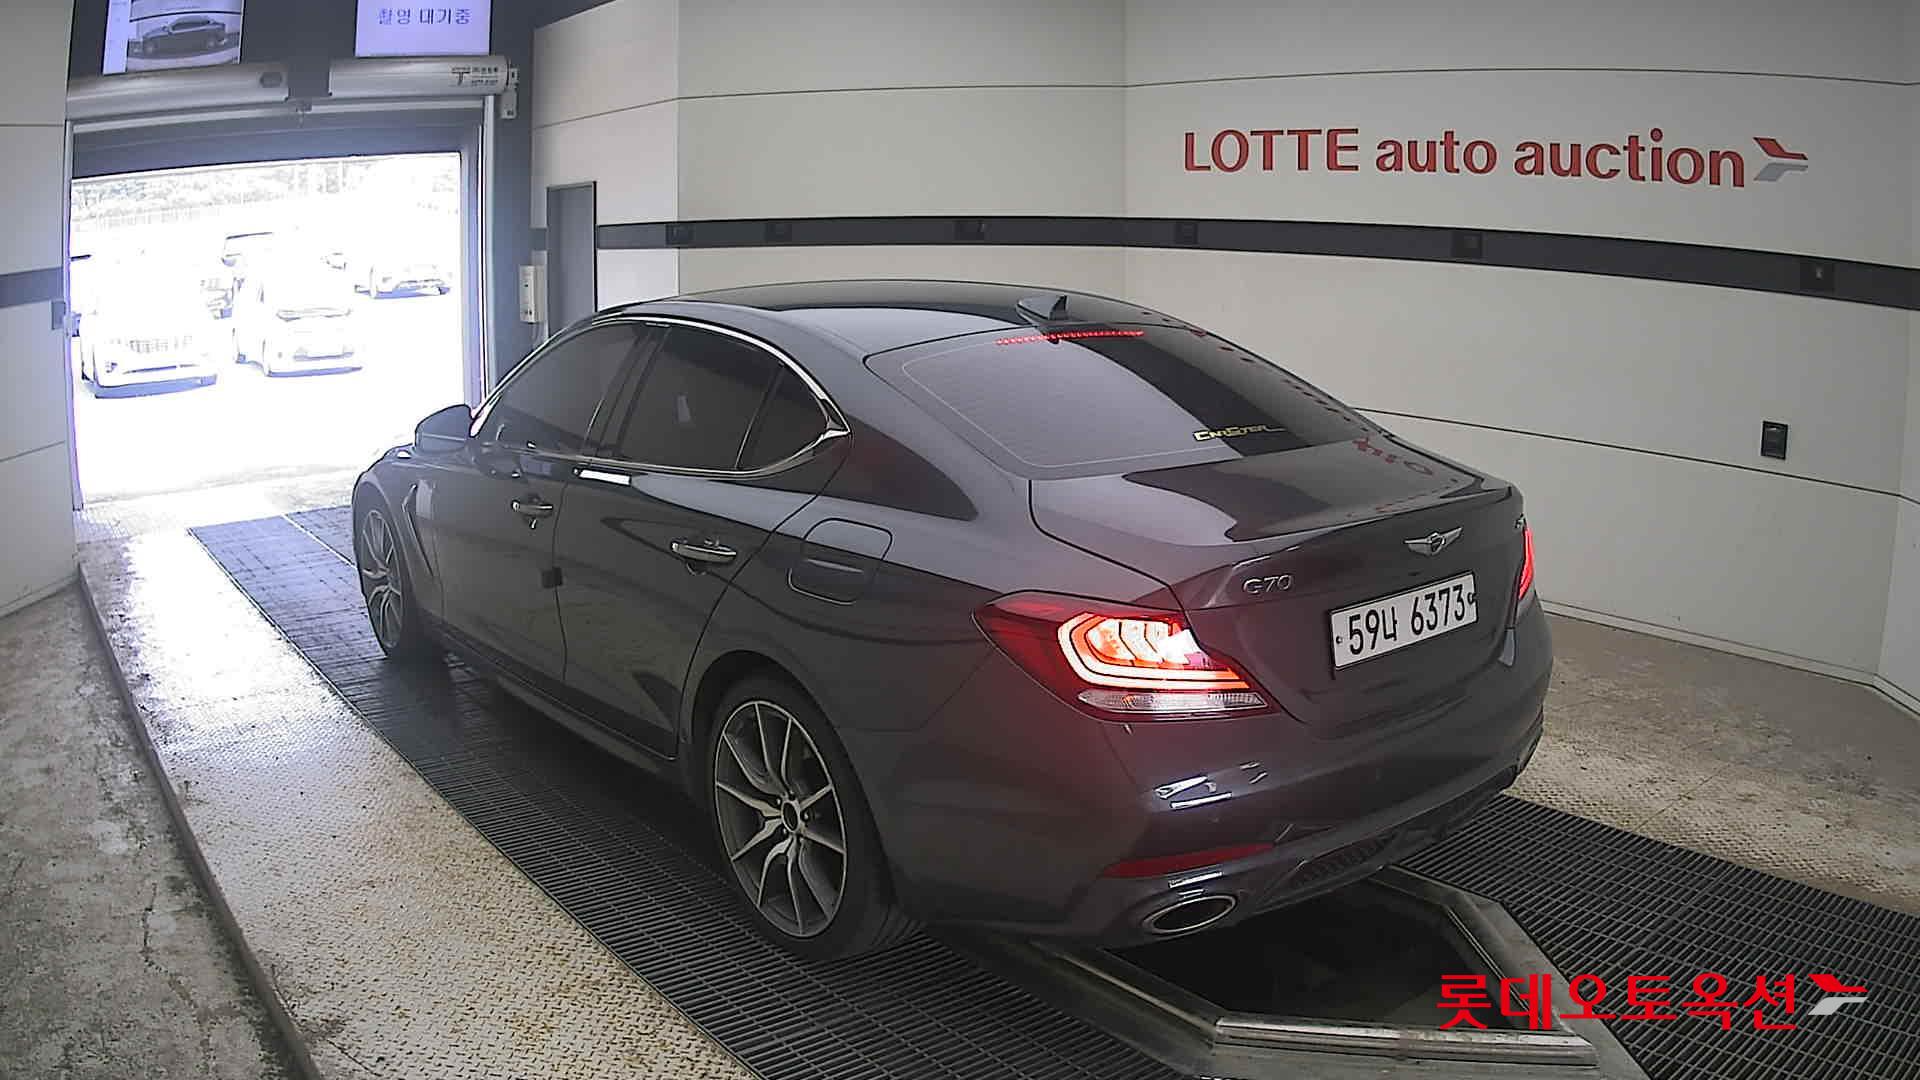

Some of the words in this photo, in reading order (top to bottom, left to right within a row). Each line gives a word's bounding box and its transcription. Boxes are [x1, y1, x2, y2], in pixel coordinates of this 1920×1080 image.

[419, 7, 471, 25] 대기중
[1184, 128, 1359, 173] LOTTE
[1376, 130, 1498, 175] auto
[1514, 128, 1746, 188] auction
[1242, 574, 1292, 594] G70
[1349, 606, 1398, 655] 59나
[1411, 584, 1466, 635] 6373
